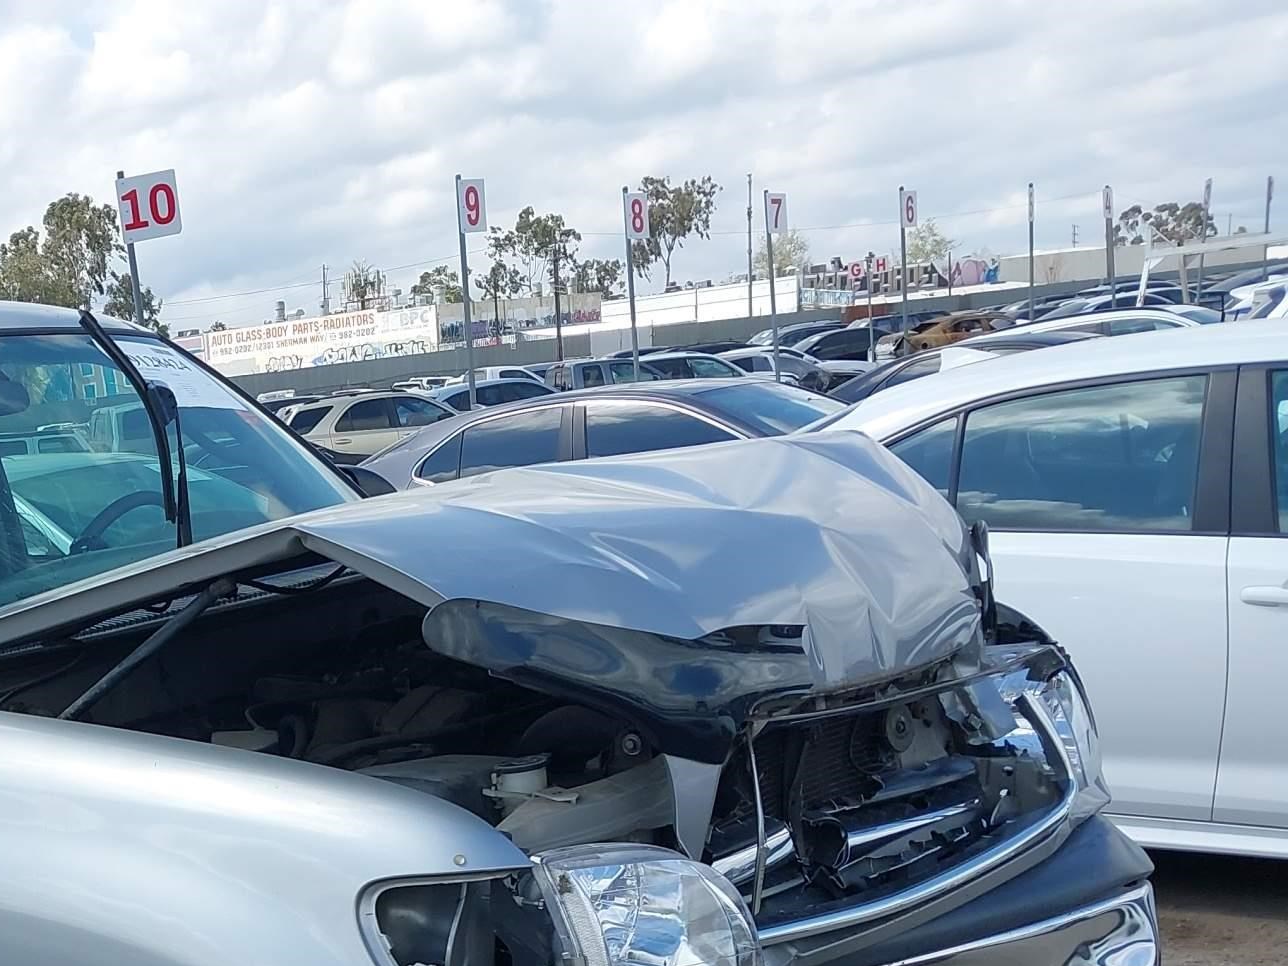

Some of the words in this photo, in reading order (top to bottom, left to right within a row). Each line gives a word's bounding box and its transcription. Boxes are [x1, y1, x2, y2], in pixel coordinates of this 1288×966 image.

[121, 182, 177, 231] 10
[465, 186, 480, 226] 9
[631, 199, 644, 233] 8
[770, 198, 783, 229] 7
[905, 195, 915, 224] 6
[851, 263, 862, 277] G
[876, 258, 886, 272] H
[212, 333, 233, 346] AUTO
